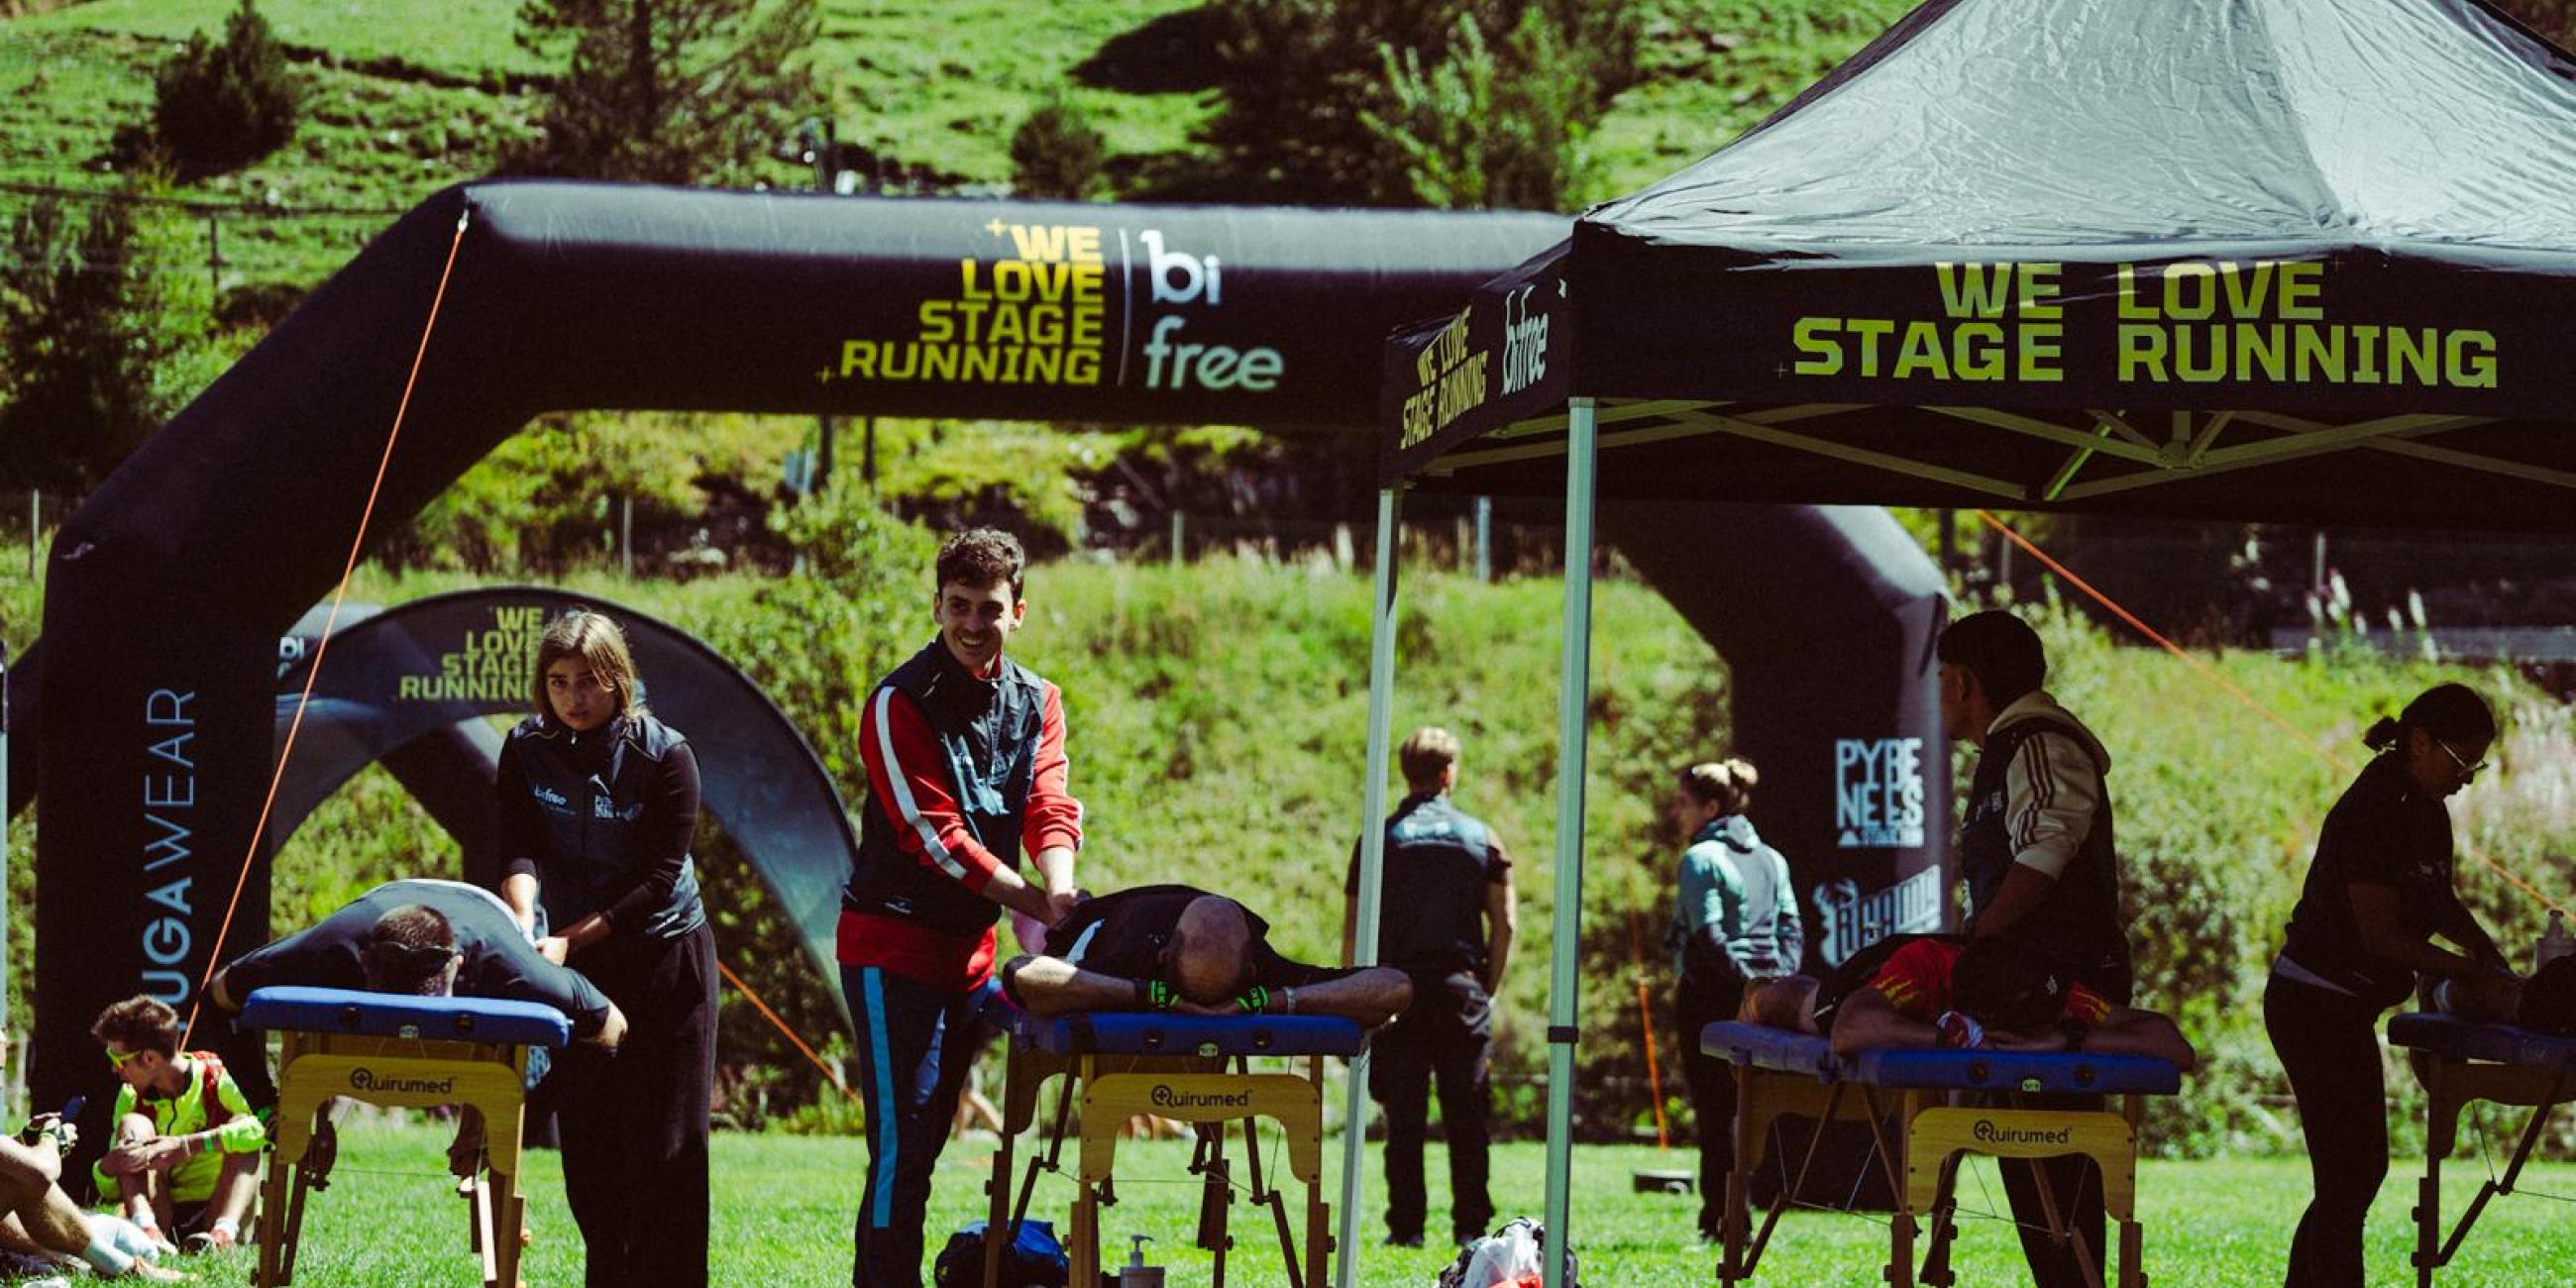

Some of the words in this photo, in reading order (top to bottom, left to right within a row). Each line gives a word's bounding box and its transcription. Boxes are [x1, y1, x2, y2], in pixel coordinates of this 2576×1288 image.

[1010, 225, 1101, 262] WE
[1139, 229, 1222, 305] bi
[961, 259, 1106, 304] LOVE
[1934, 261, 2064, 319] WE
[2116, 261, 2324, 321] LOVE
[919, 300, 1105, 347] STAGE
[1440, 305, 1471, 374] LOVE
[840, 339, 1101, 384] RUNNING
[1143, 315, 1283, 389] free
[1792, 317, 2064, 383] STAGE
[2116, 323, 2498, 388] RUNNING
[1400, 384, 1436, 450] STAGE
[1437, 350, 1488, 430] RUNNING
[495, 606, 544, 630] WE
[142, 688, 196, 1032] UGAWEAR
[350, 1067, 453, 1094] Quirumed
[1151, 1084, 1248, 1108] Quirumed
[1974, 1120, 2069, 1143] Quirumed
